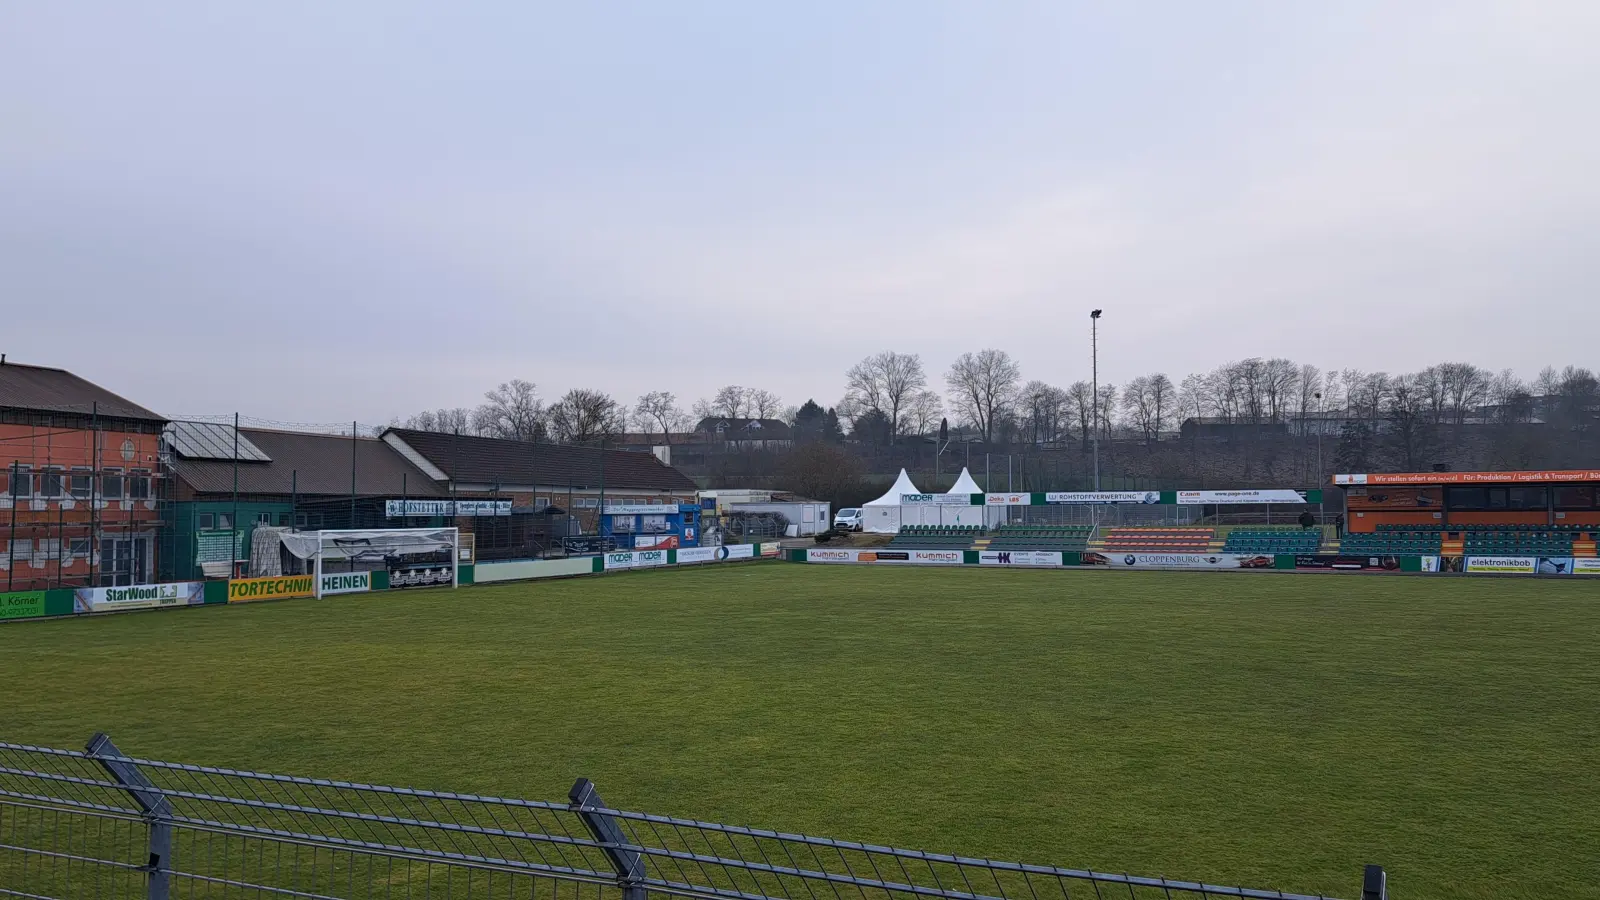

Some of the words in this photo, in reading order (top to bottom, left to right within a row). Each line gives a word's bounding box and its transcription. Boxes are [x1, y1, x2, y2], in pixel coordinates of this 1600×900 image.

[1512, 472, 1517, 481] /
[1518, 473, 1543, 481] Logistik
[1551, 473, 1583, 481] Transport
[1139, 555, 1200, 563] CLOPPENBURG
[1471, 558, 1531, 567] elektronikbob
[322, 575, 368, 590] HEINEN
[106, 586, 158, 602] StarWood
[8, 595, 40, 606] Körner
